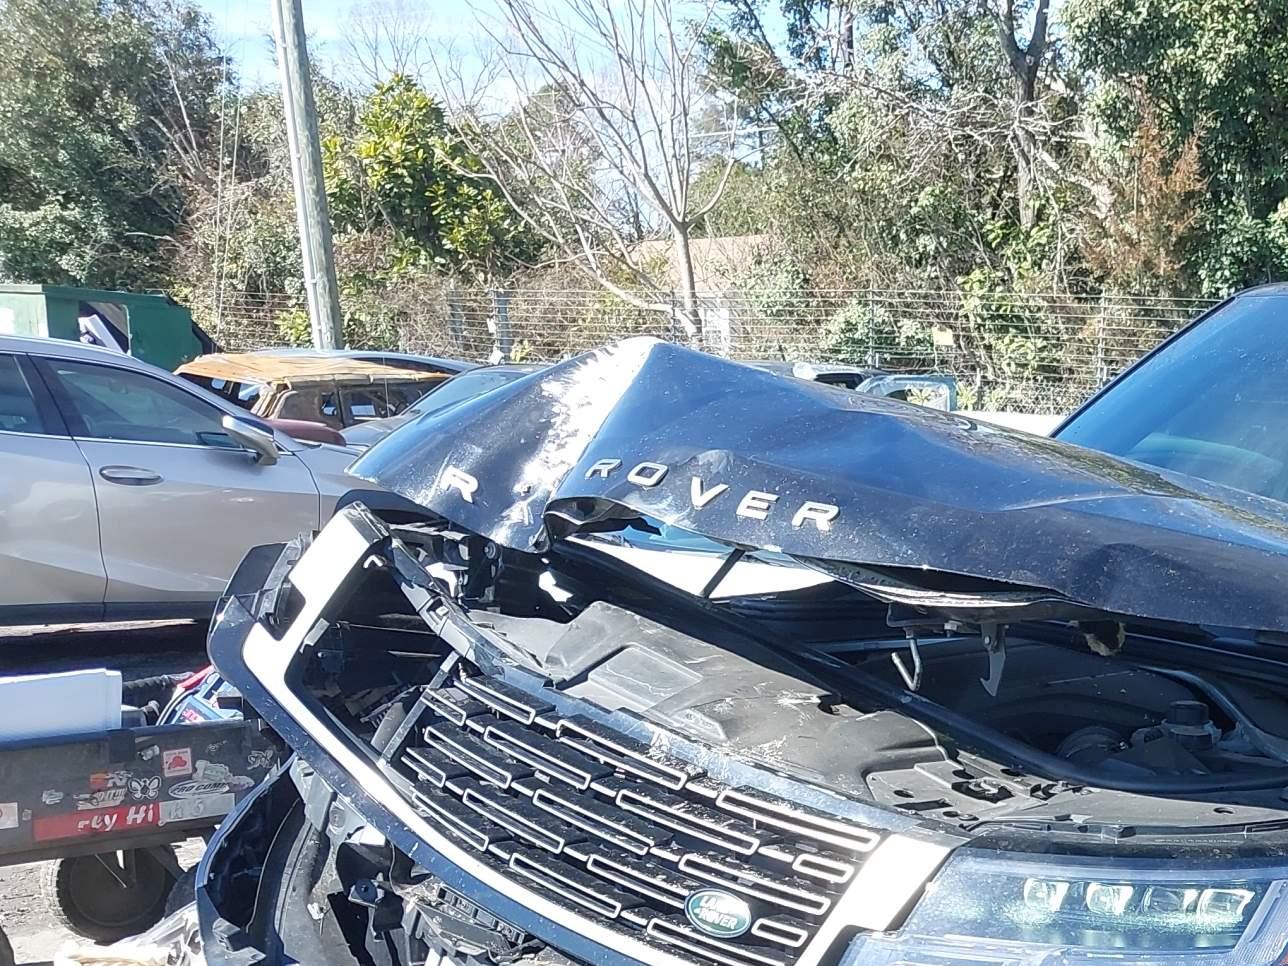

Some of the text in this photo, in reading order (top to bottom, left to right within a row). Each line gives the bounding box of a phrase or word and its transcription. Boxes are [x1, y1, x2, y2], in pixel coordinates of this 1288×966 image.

[440, 458, 842, 533] R ROVER
[697, 908, 738, 930] ROVER
